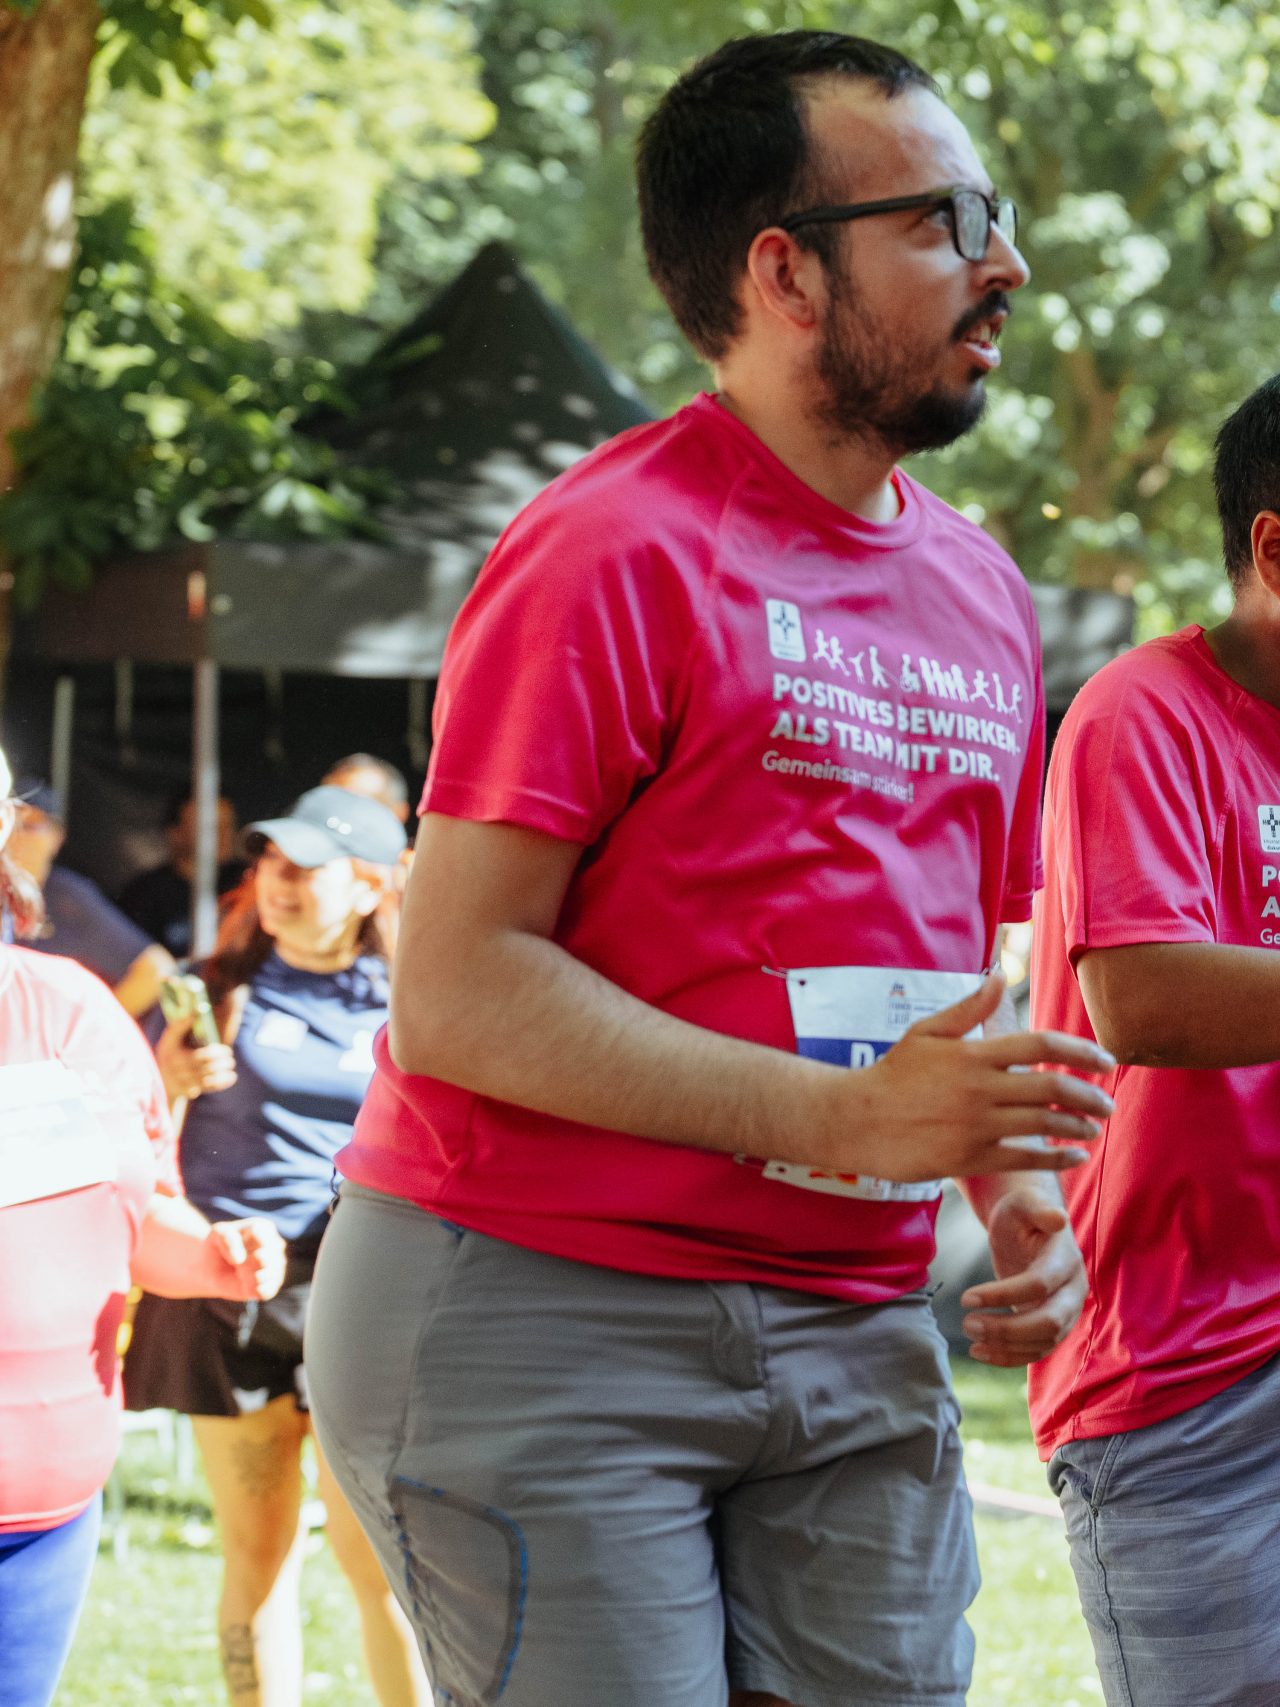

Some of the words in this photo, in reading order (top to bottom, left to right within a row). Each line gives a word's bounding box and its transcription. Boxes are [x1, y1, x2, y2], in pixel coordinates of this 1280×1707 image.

[770, 711, 829, 746] ALS
[833, 720, 893, 763] TEAM
[895, 741, 941, 773] MIT
[948, 748, 1000, 782] DIR.
[773, 673, 894, 727] POSITIVES
[897, 704, 1021, 756] BEWIRKEN.
[762, 750, 871, 790] Gemeinsam
